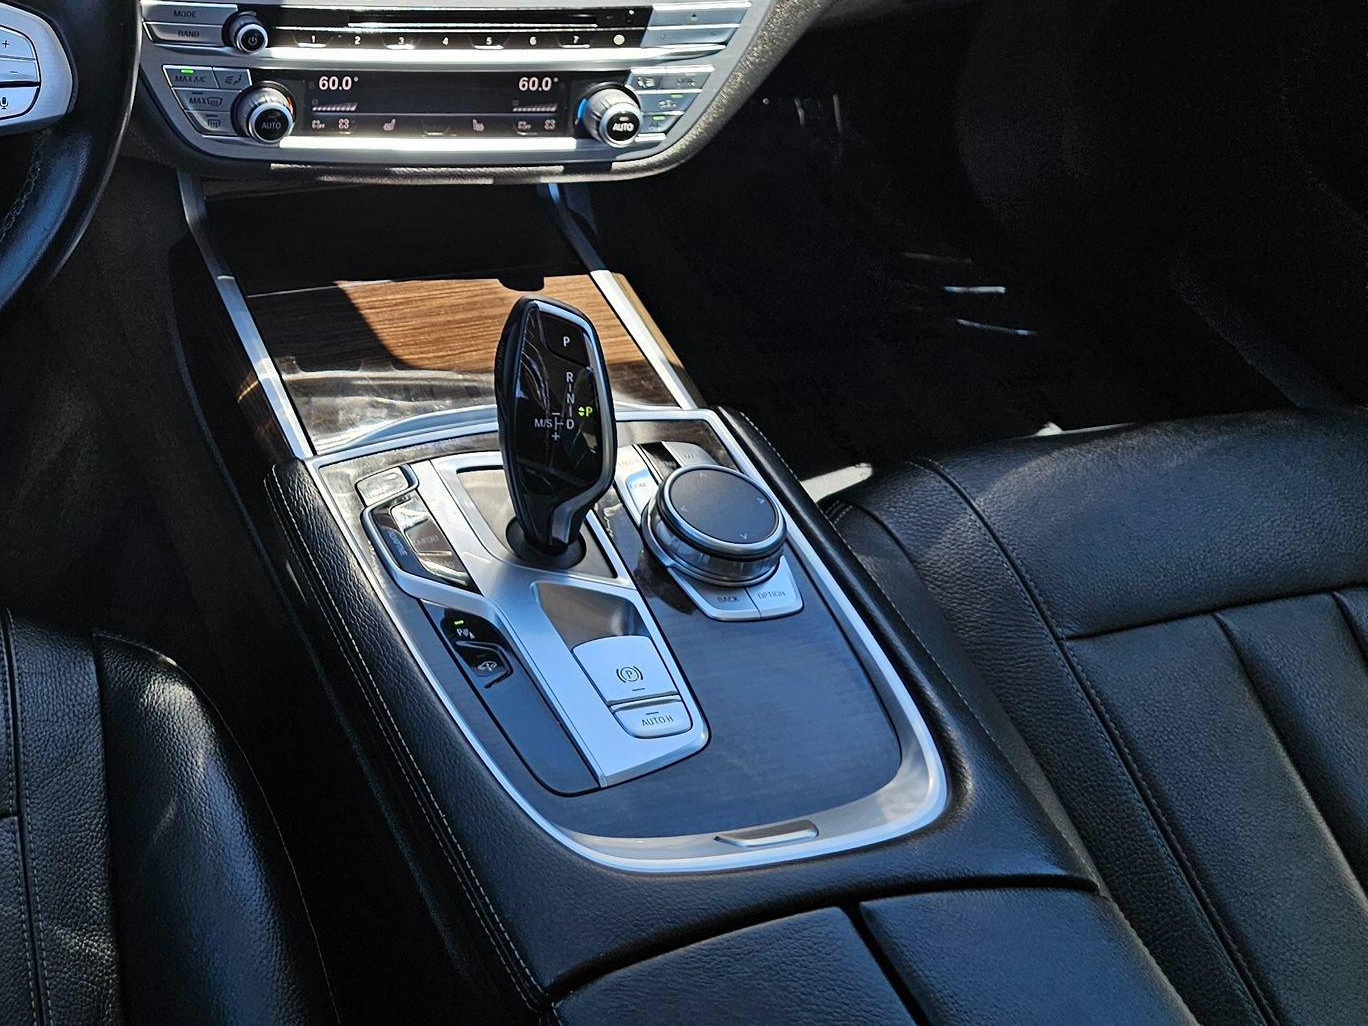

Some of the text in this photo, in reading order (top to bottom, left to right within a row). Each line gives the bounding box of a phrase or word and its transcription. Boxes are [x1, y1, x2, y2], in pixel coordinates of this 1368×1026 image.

[173, 10, 197, 18] MODE
[178, 30, 200, 38] BAND
[310, 36, 316, 44] 1
[354, 36, 360, 44] 2
[573, 36, 579, 44] 7
[318, 75, 359, 91] 60.0°
[518, 76, 559, 92] 60.0°
[189, 97, 207, 105] MAX
[261, 120, 282, 130] AUTO
[611, 121, 634, 132] AUTO
[562, 337, 571, 347] P
[566, 373, 575, 383] R
[567, 393, 575, 404] N
[584, 407, 593, 417] P
[534, 419, 575, 430] M/S D
[717, 595, 740, 604] BACK
[757, 590, 786, 599] OPTION
[641, 715, 674, 727] AUTO H
